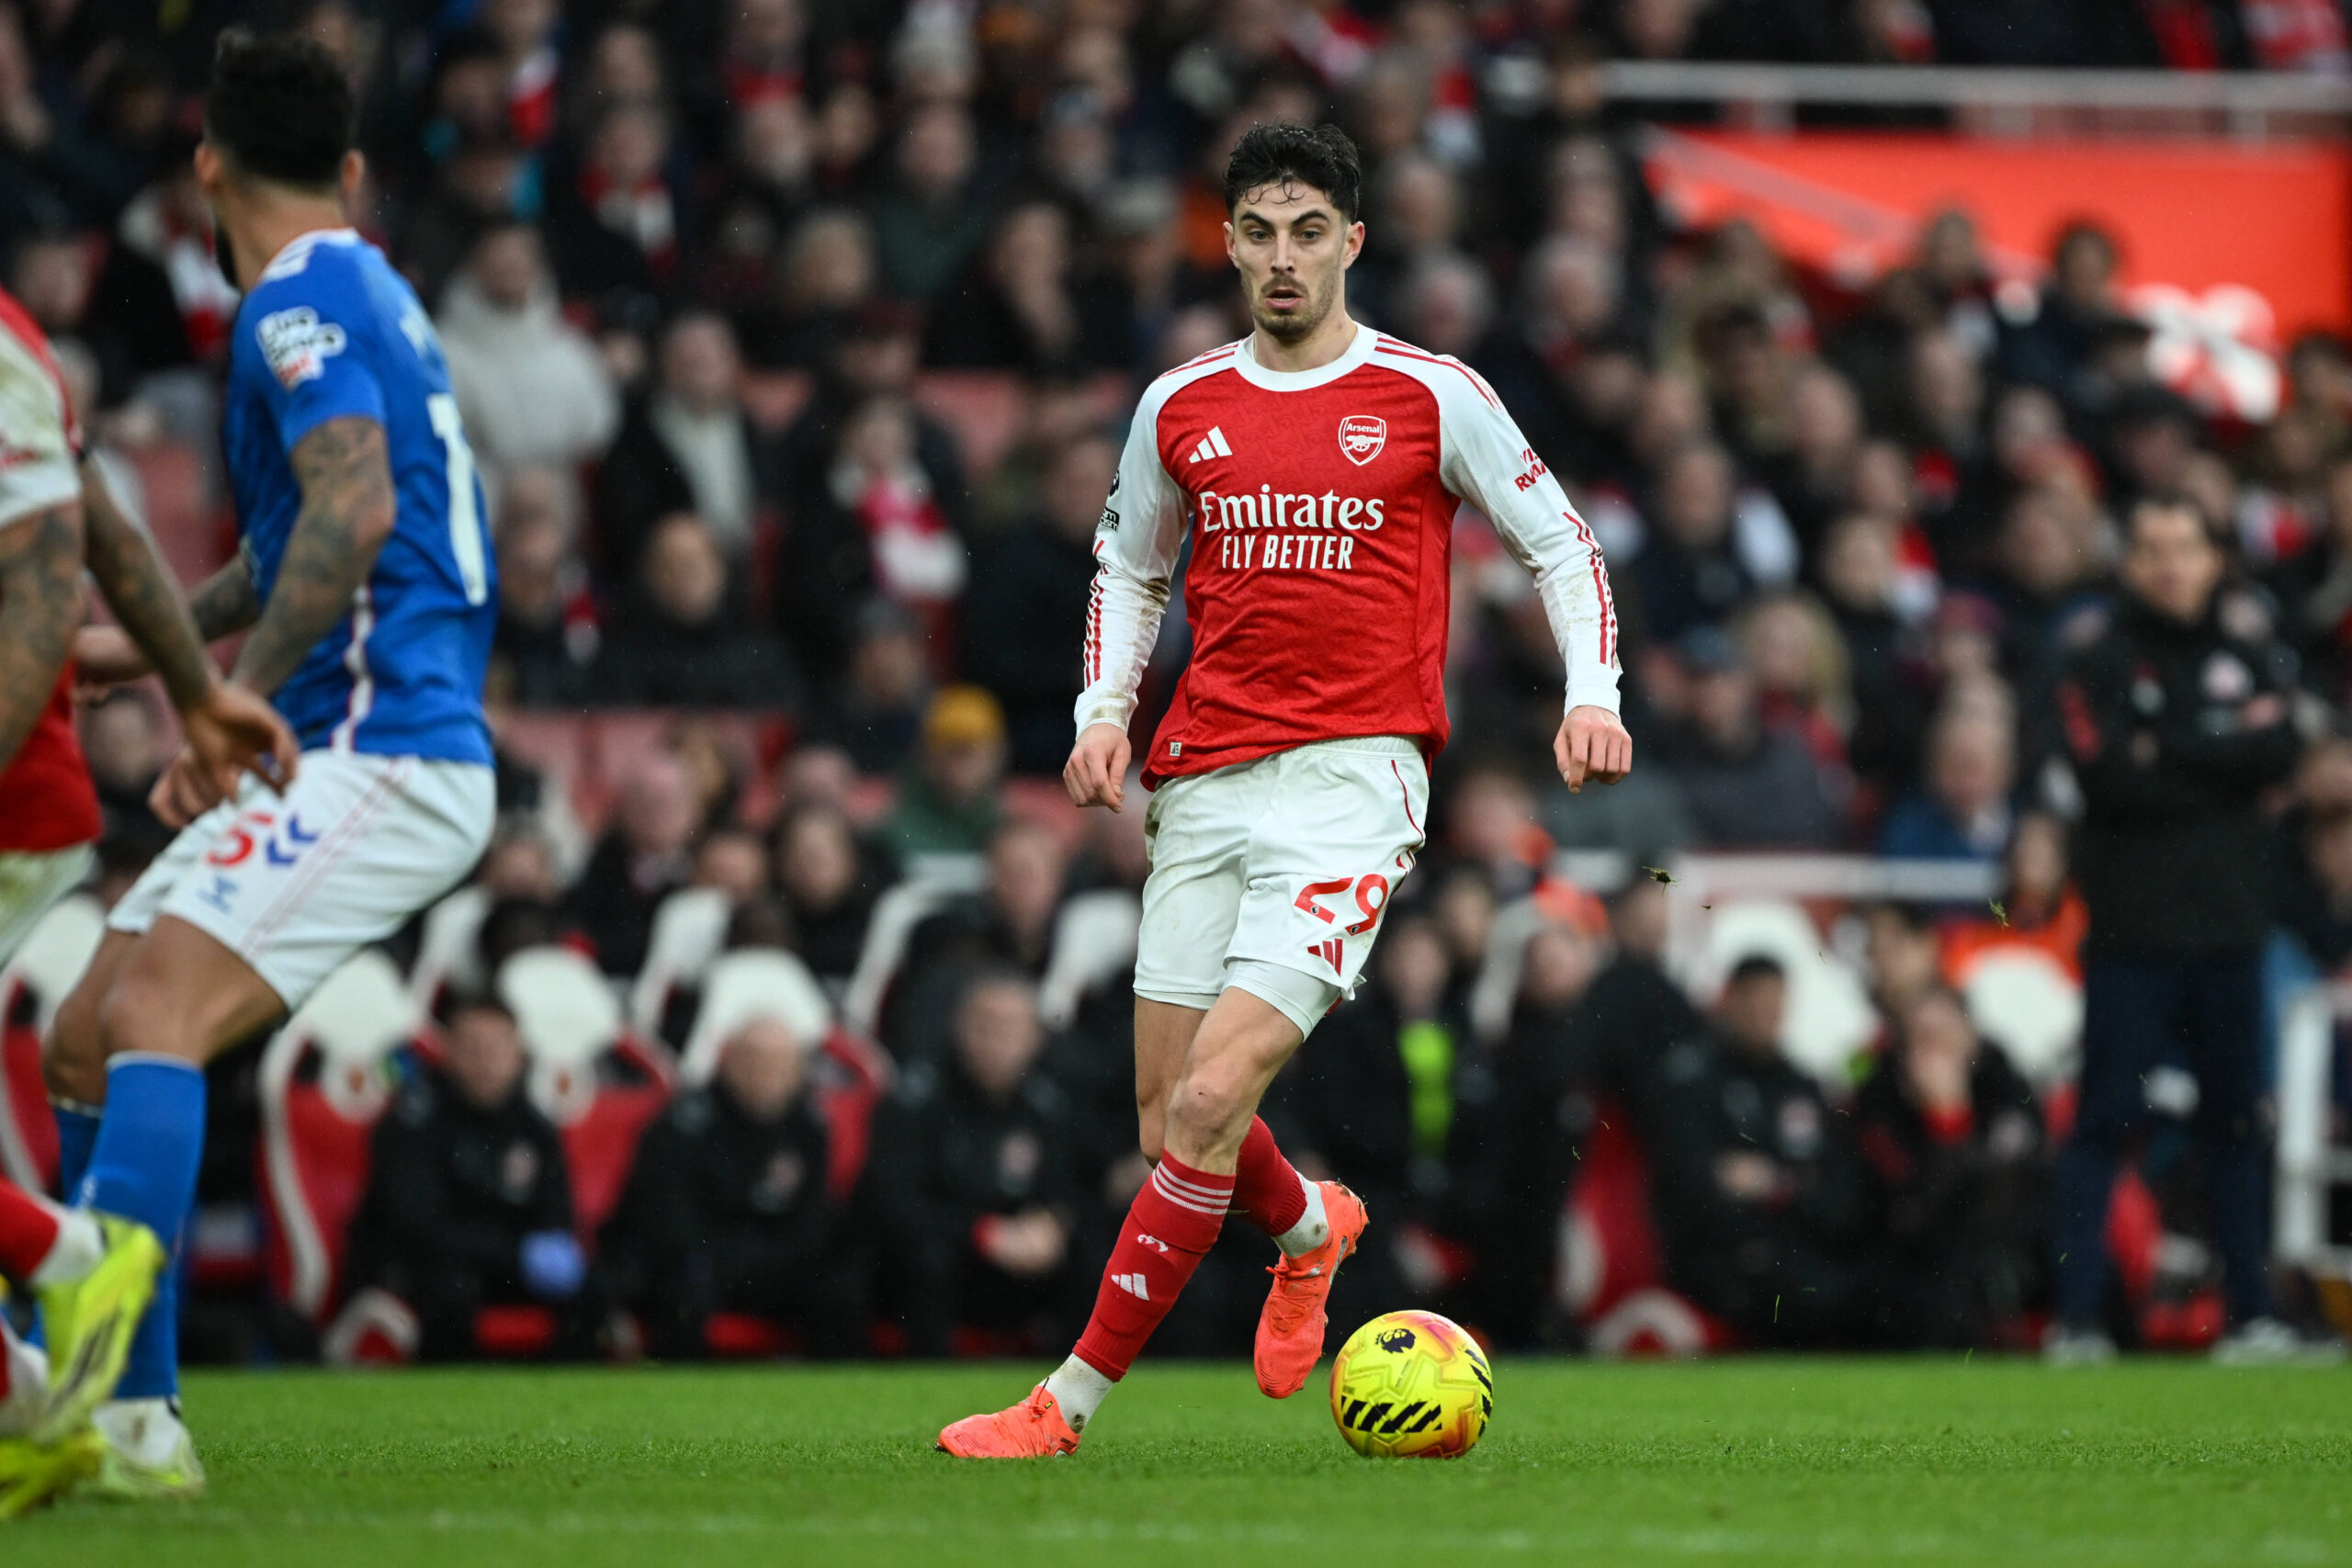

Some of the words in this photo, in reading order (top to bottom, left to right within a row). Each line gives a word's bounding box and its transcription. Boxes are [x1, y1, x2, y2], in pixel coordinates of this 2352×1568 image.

[1346, 423, 1380, 434] Arsenal
[1198, 483, 1385, 533] Emirates
[1222, 534, 1256, 570] FLY
[1261, 534, 1354, 570] BETTER
[1294, 874, 1389, 937] 29
